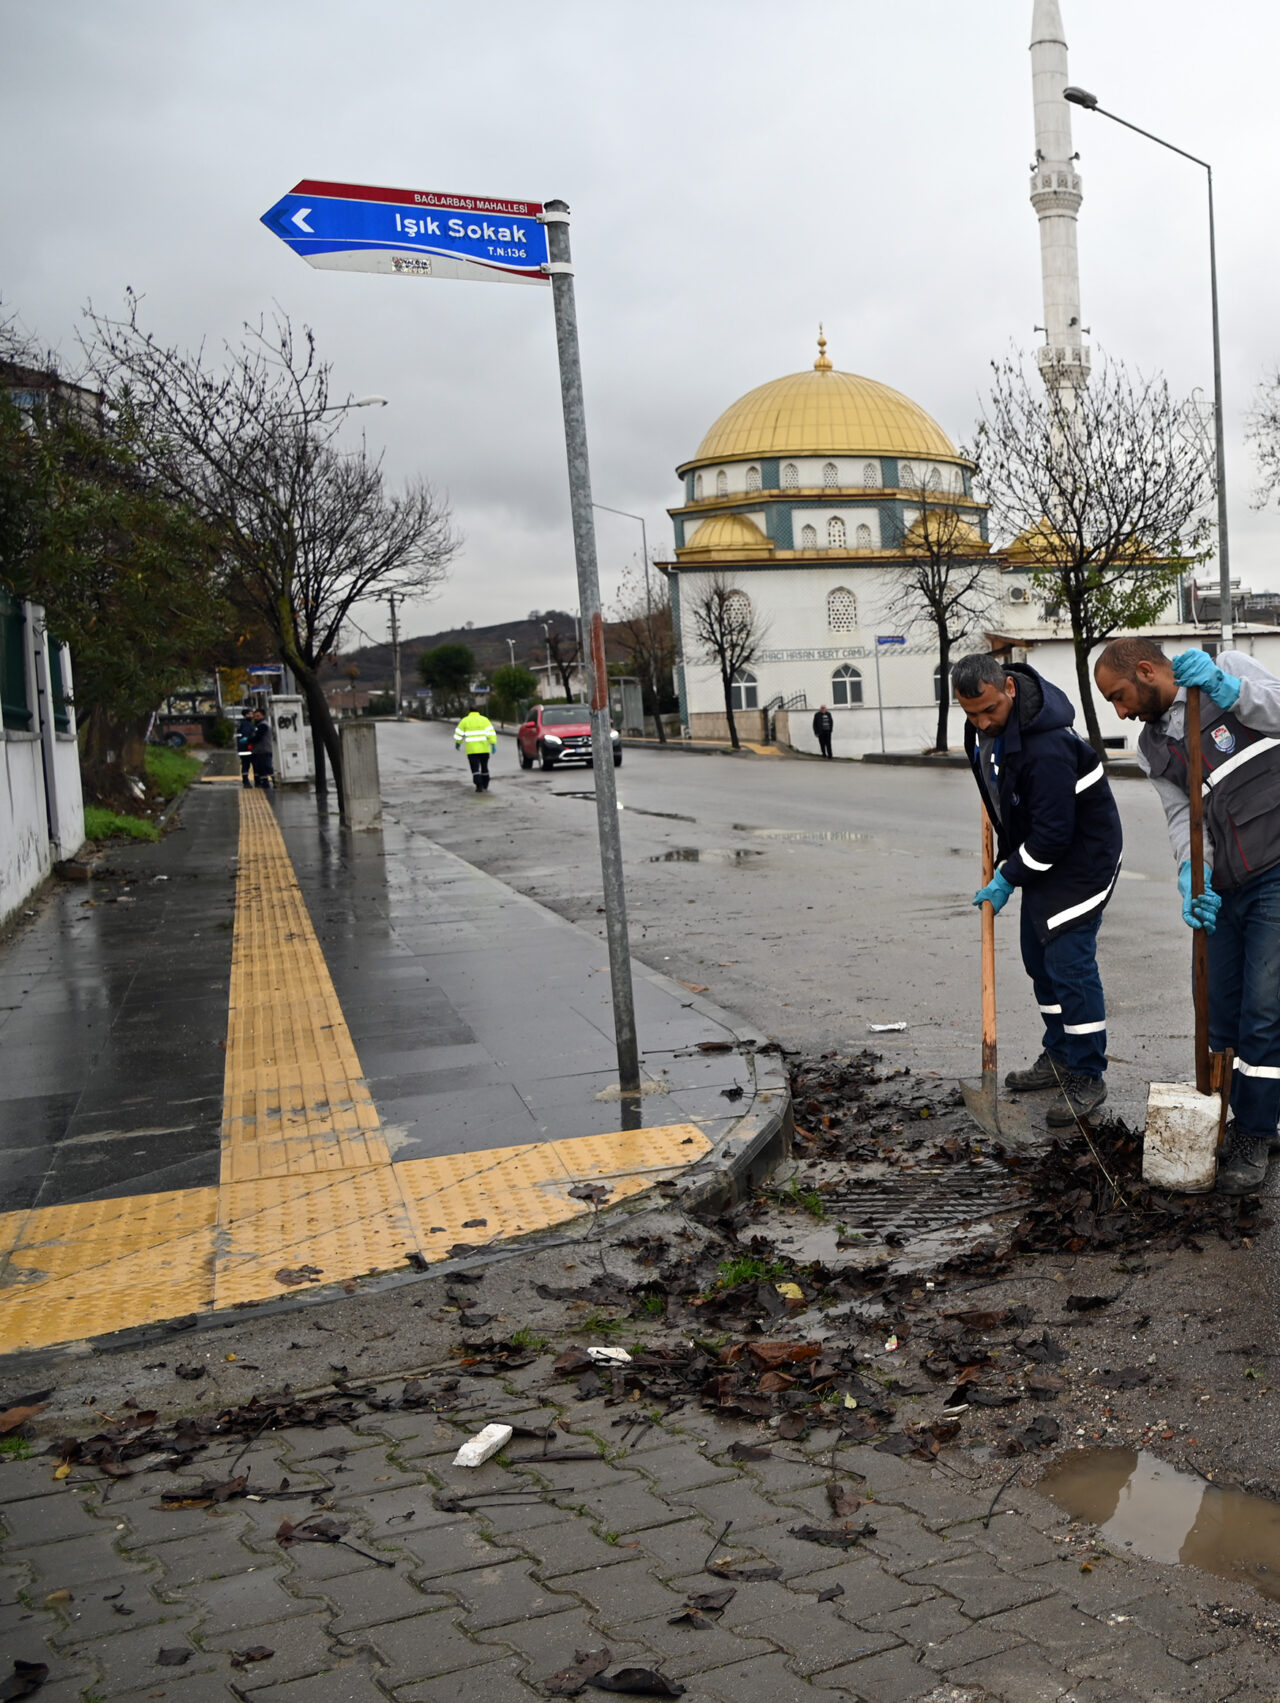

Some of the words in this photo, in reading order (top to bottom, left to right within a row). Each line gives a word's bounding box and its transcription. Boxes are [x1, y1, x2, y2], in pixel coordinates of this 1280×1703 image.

[414, 193, 475, 209] BAĞLARBAŞI
[476, 200, 528, 213] MAHALLESİ
[395, 213, 441, 237] Işık
[448, 218, 527, 243] Sokak
[487, 246, 527, 258] T.N:136
